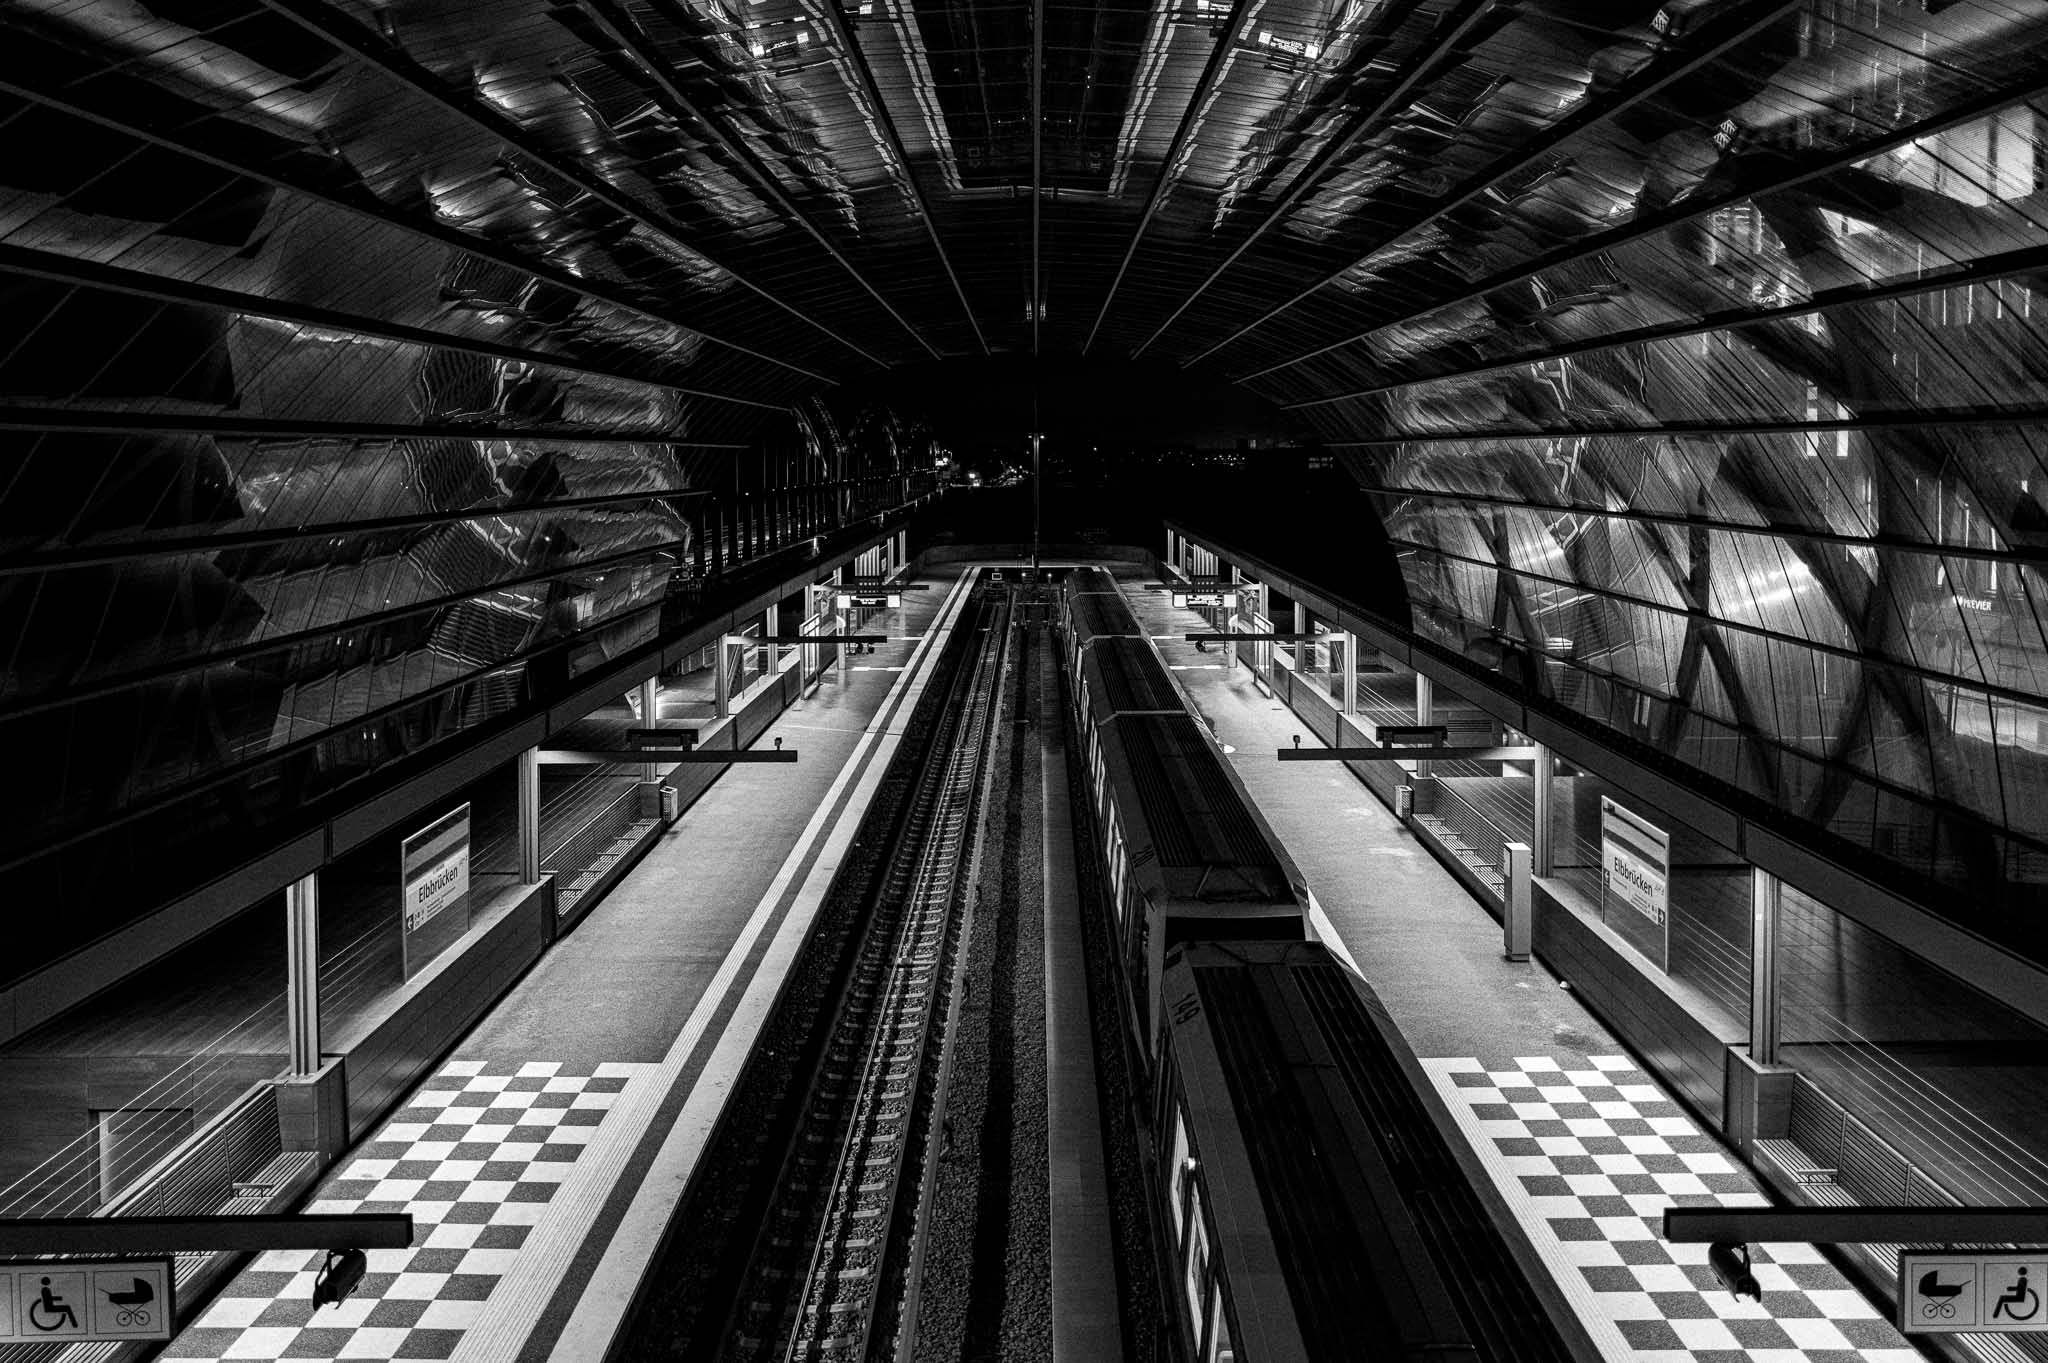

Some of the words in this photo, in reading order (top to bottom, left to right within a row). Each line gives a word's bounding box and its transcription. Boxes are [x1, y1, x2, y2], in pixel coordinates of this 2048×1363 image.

[418, 866, 459, 904] Elbbrücken
[1614, 857, 1653, 897] Elbbrücken
[1171, 993, 1201, 1025] 149
